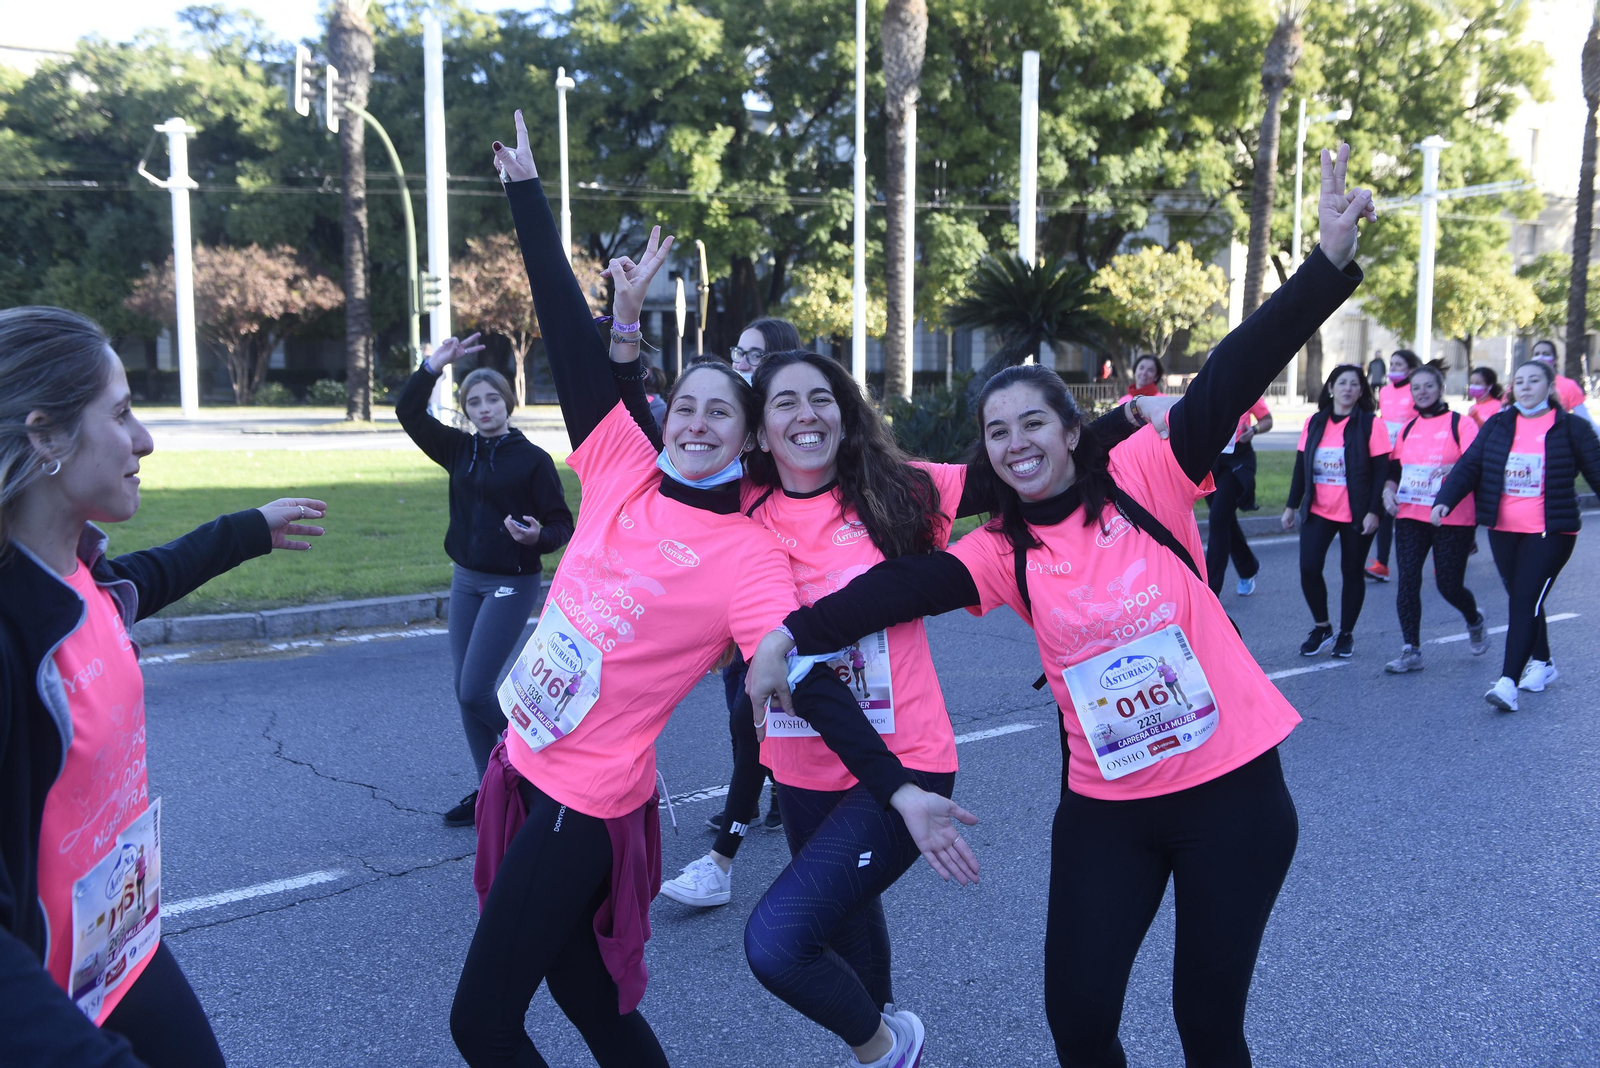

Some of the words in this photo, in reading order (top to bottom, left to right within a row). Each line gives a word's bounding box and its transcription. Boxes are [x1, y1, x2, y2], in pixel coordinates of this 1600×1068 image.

[1411, 480, 1428, 488] 016
[1506, 470, 1526, 478] 016
[1027, 560, 1072, 576] OYSHO
[588, 591, 631, 636] TODAS
[612, 588, 645, 620] POR
[1123, 584, 1162, 614] POR
[556, 588, 616, 652] NOSOTRAS
[1111, 603, 1171, 641] TODAS
[549, 636, 577, 671] ASTURIANA
[62, 658, 103, 694] YSHO
[531, 658, 564, 698] 016
[1106, 662, 1154, 688] ASTURIANA
[526, 684, 543, 704] 1336
[1116, 684, 1169, 718] 016
[524, 697, 532, 708] DE
[530, 704, 538, 714] LA
[536, 711, 554, 730] MUJER
[773, 720, 809, 729] OYSHO
[1137, 712, 1162, 730] 2237
[1118, 731, 1150, 748] CARRERA
[1150, 726, 1160, 734] DE
[1160, 722, 1170, 731] LA
[1170, 712, 1197, 728] MUJER
[1194, 722, 1214, 736] ZURICH
[1106, 750, 1144, 771] OYSHO
[554, 806, 566, 832] DOMYOS
